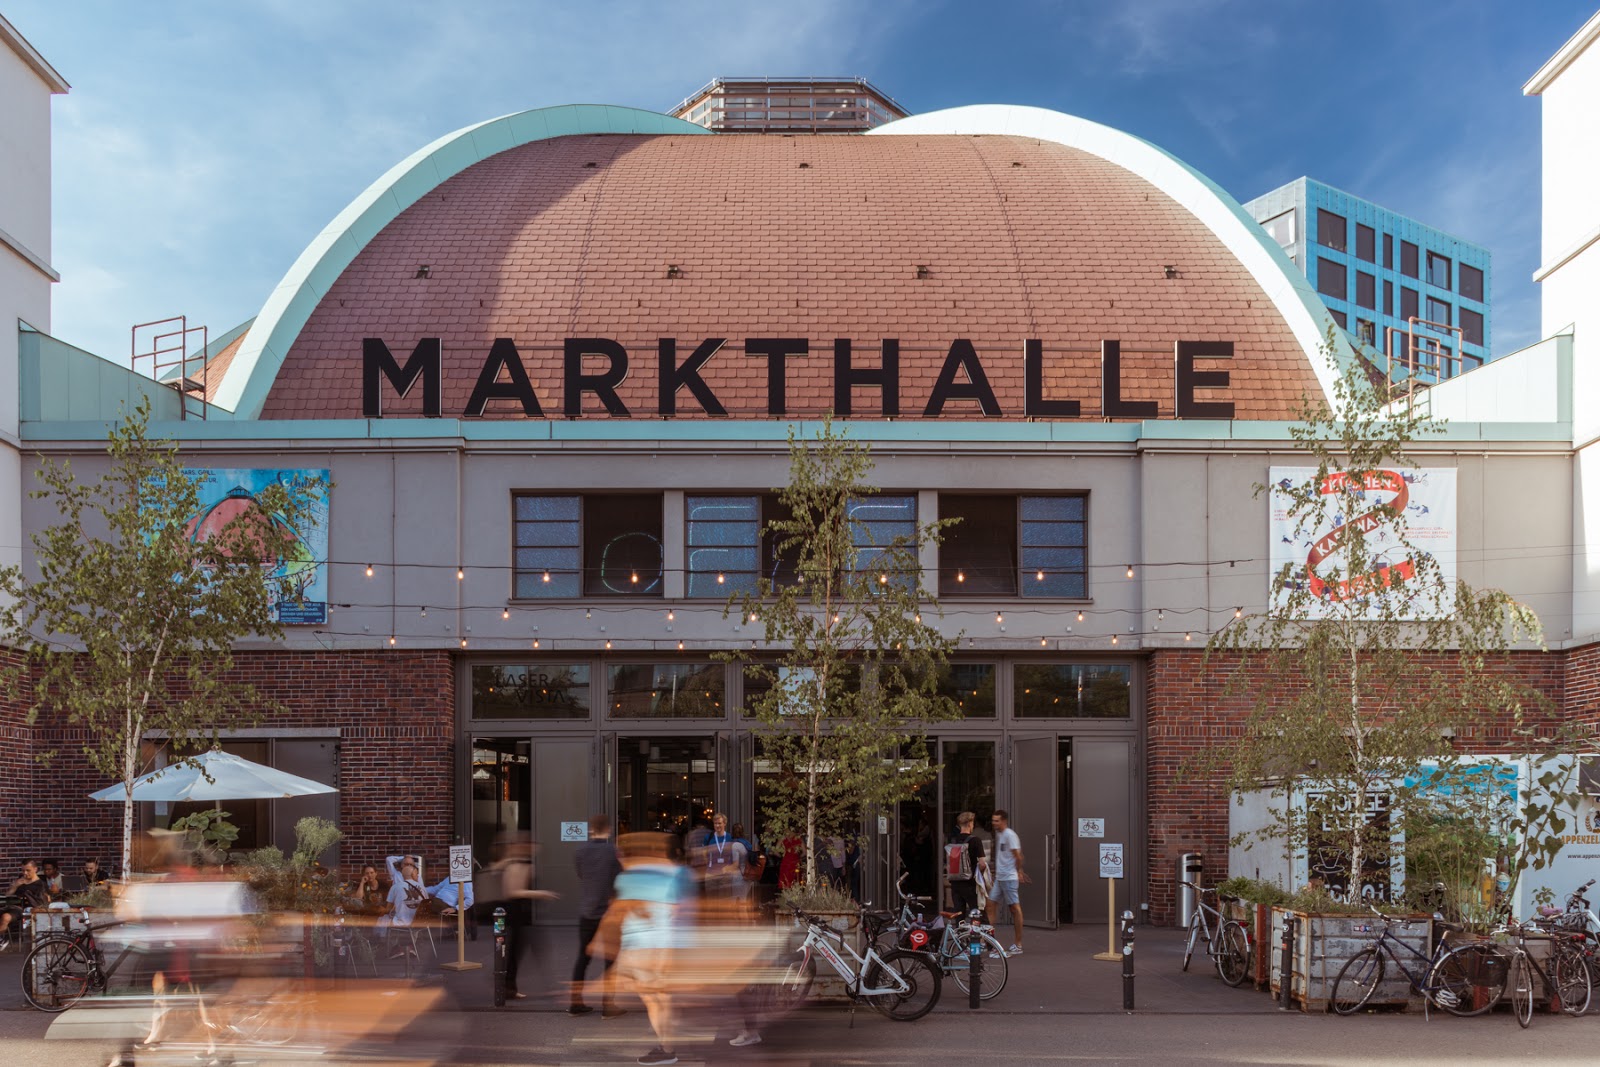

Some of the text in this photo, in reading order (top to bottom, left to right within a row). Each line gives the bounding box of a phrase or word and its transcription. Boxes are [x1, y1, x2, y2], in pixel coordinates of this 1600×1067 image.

[363, 337, 1235, 418] MARKTHALLE
[495, 673, 549, 688] LASER
[514, 689, 566, 704] VISTA
